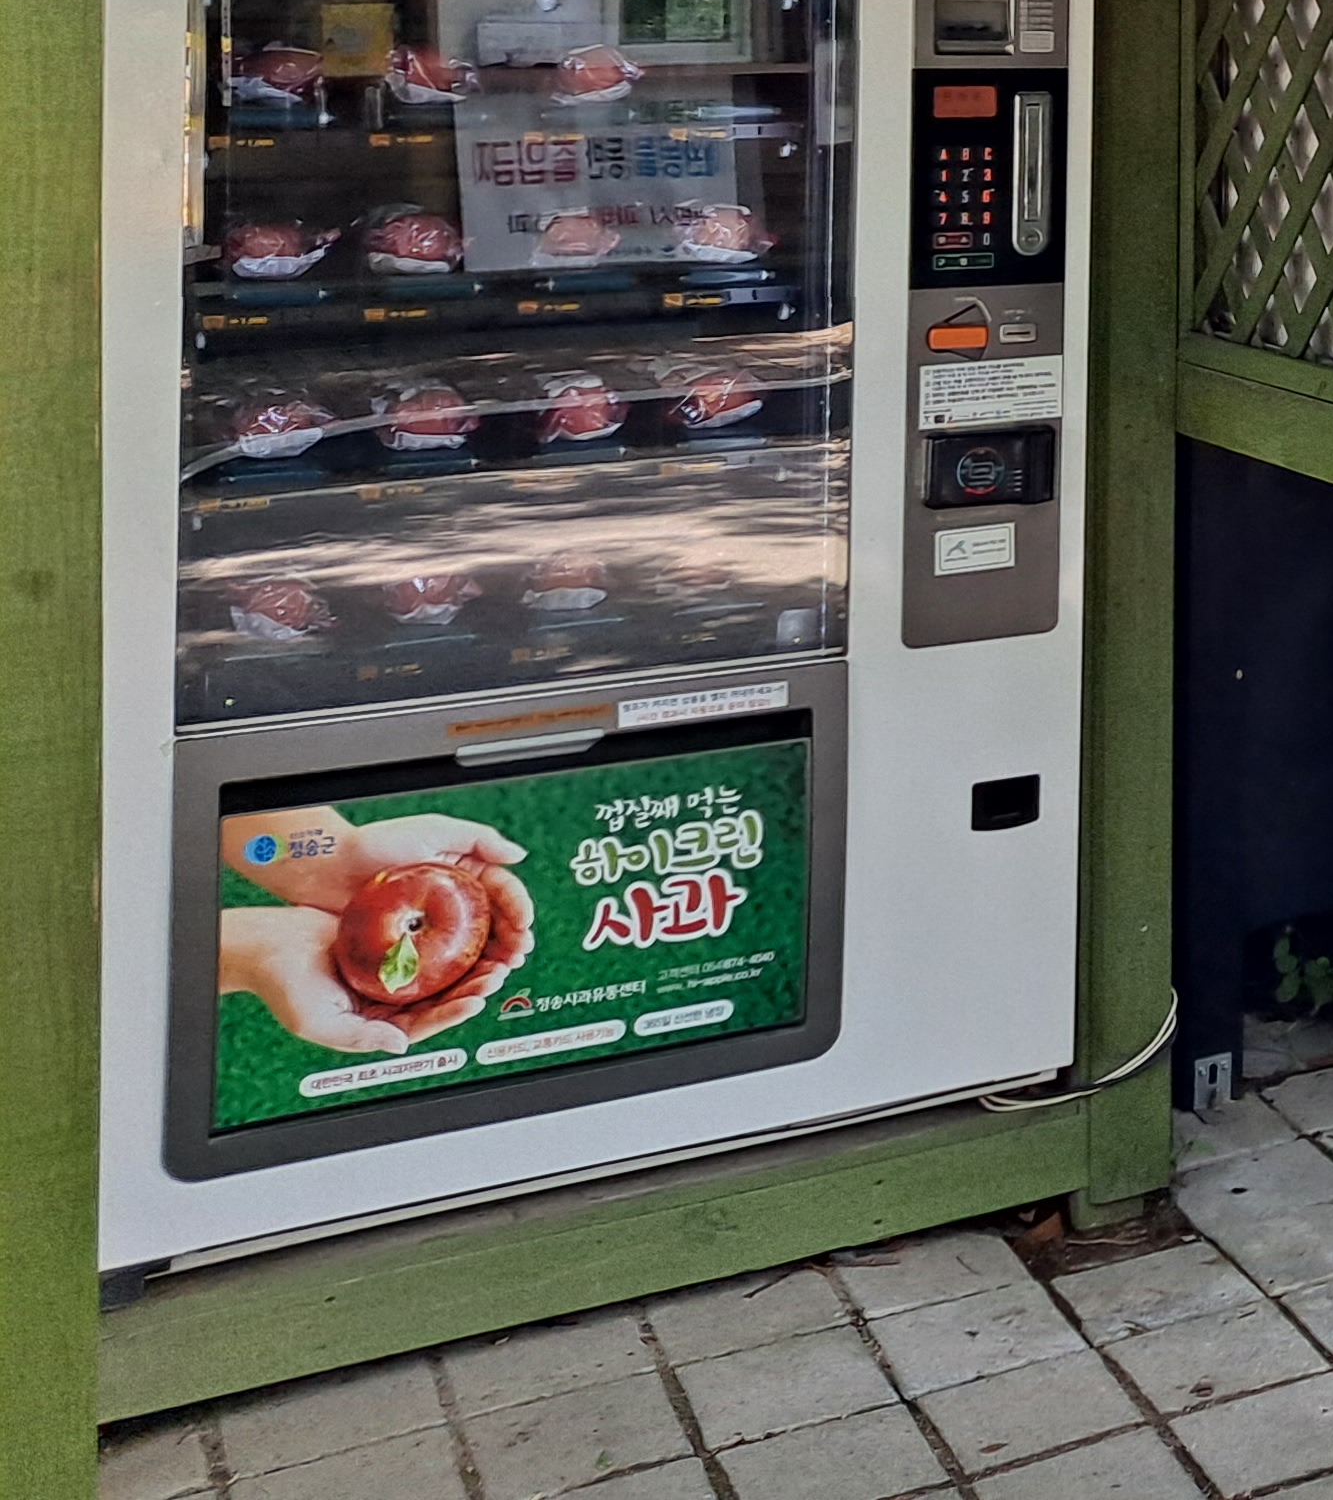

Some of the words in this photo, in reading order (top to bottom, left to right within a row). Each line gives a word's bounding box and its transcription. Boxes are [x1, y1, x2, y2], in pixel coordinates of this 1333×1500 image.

[569, 809, 764, 886] 하이크린
[594, 794, 680, 833] 껍질째
[687, 785, 743, 819] 먹는
[582, 868, 748, 951] 사과
